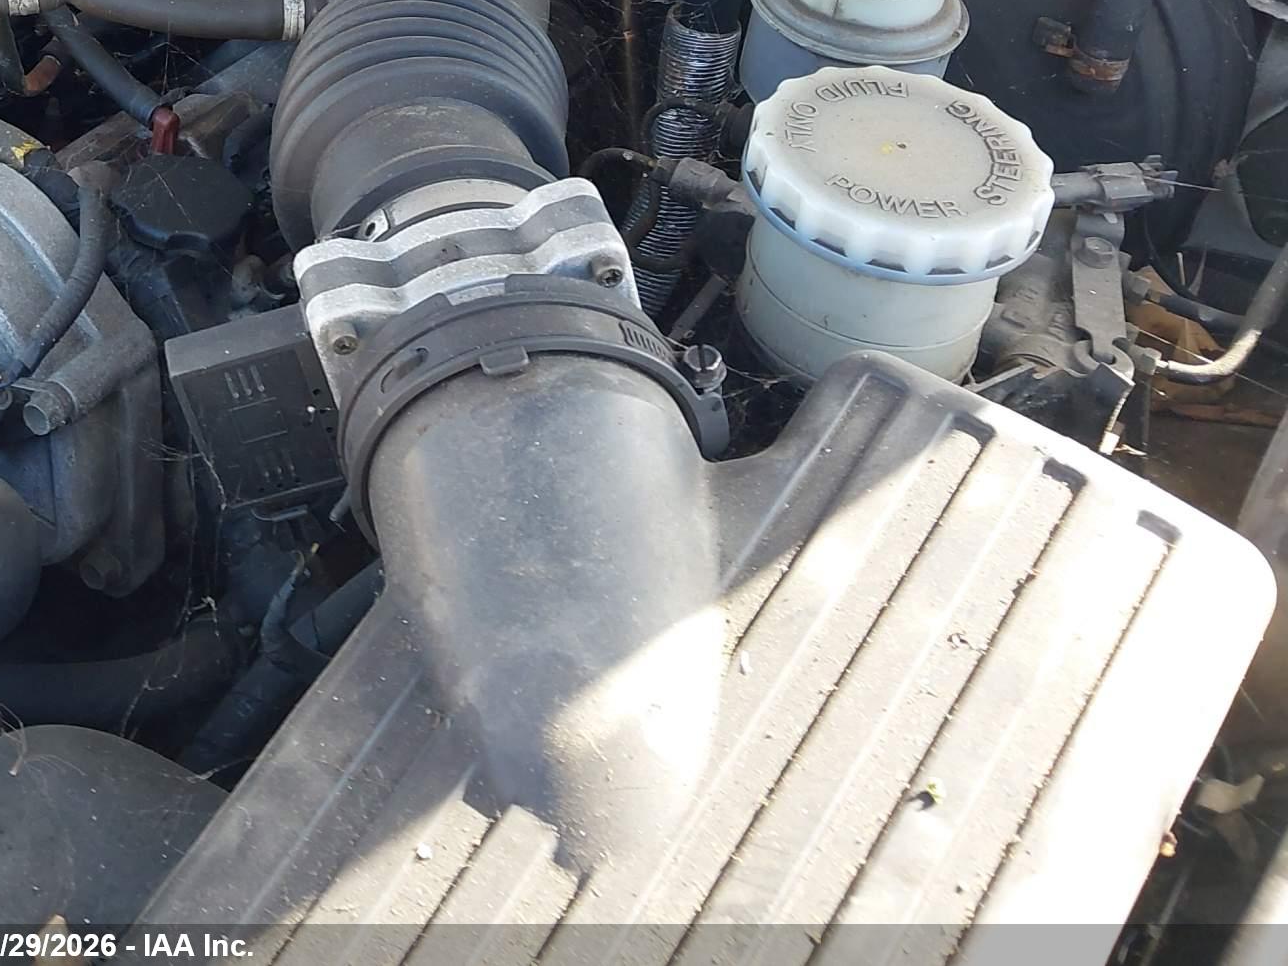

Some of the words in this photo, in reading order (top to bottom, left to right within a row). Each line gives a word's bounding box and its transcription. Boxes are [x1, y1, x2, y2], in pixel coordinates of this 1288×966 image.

[815, 78, 910, 103] FLUID
[784, 100, 818, 153] ONLY
[945, 100, 1023, 206] STEERING
[824, 173, 968, 219] POWER
